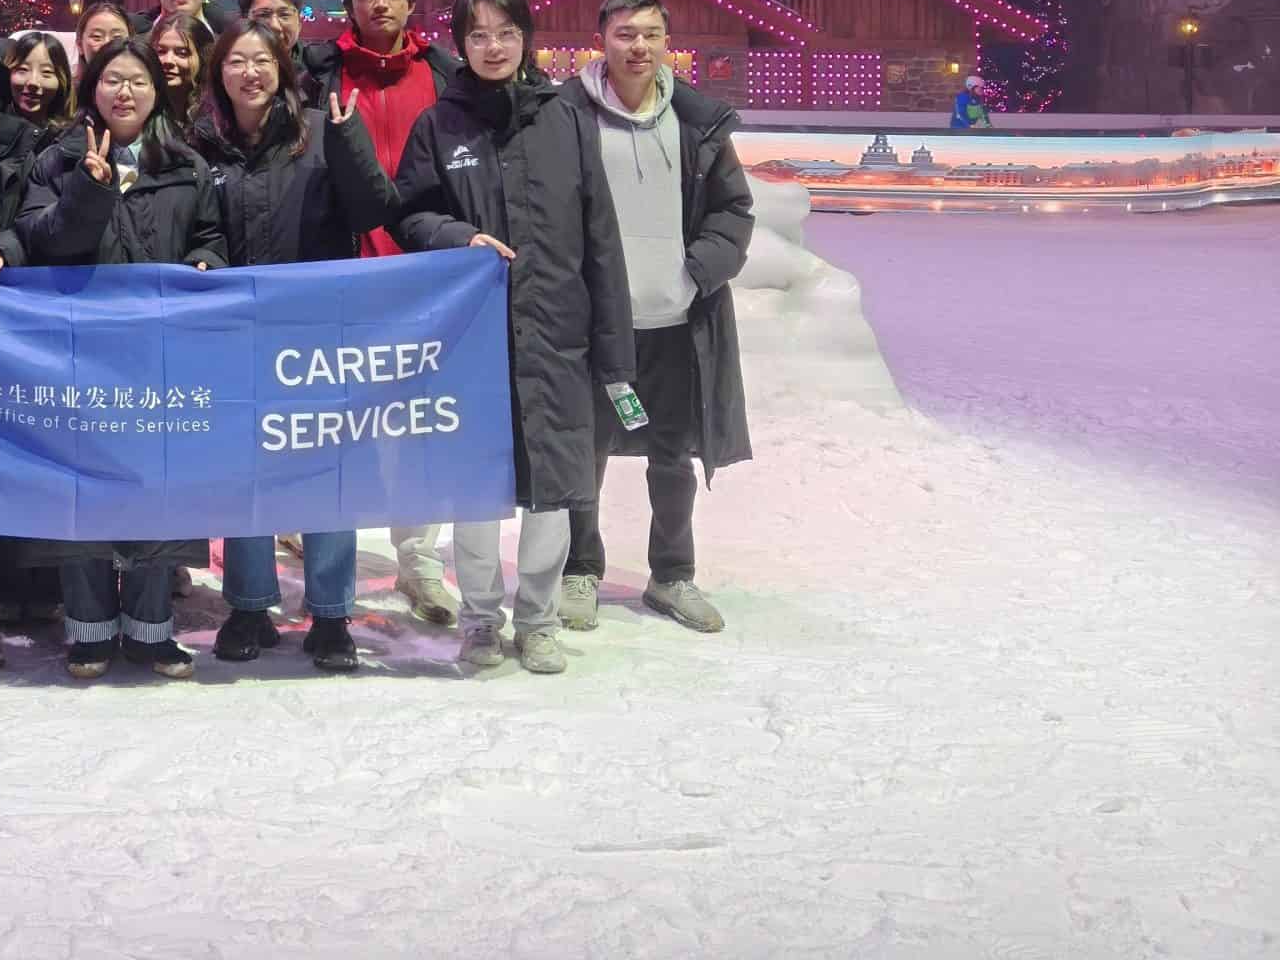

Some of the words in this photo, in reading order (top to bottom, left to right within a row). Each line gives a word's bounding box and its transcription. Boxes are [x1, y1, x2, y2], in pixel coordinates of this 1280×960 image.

[275, 341, 442, 386] CAREER
[43, 415, 60, 429] of
[68, 417, 128, 433] Career
[136, 418, 211, 433] Services
[261, 396, 460, 451] SERVICES
